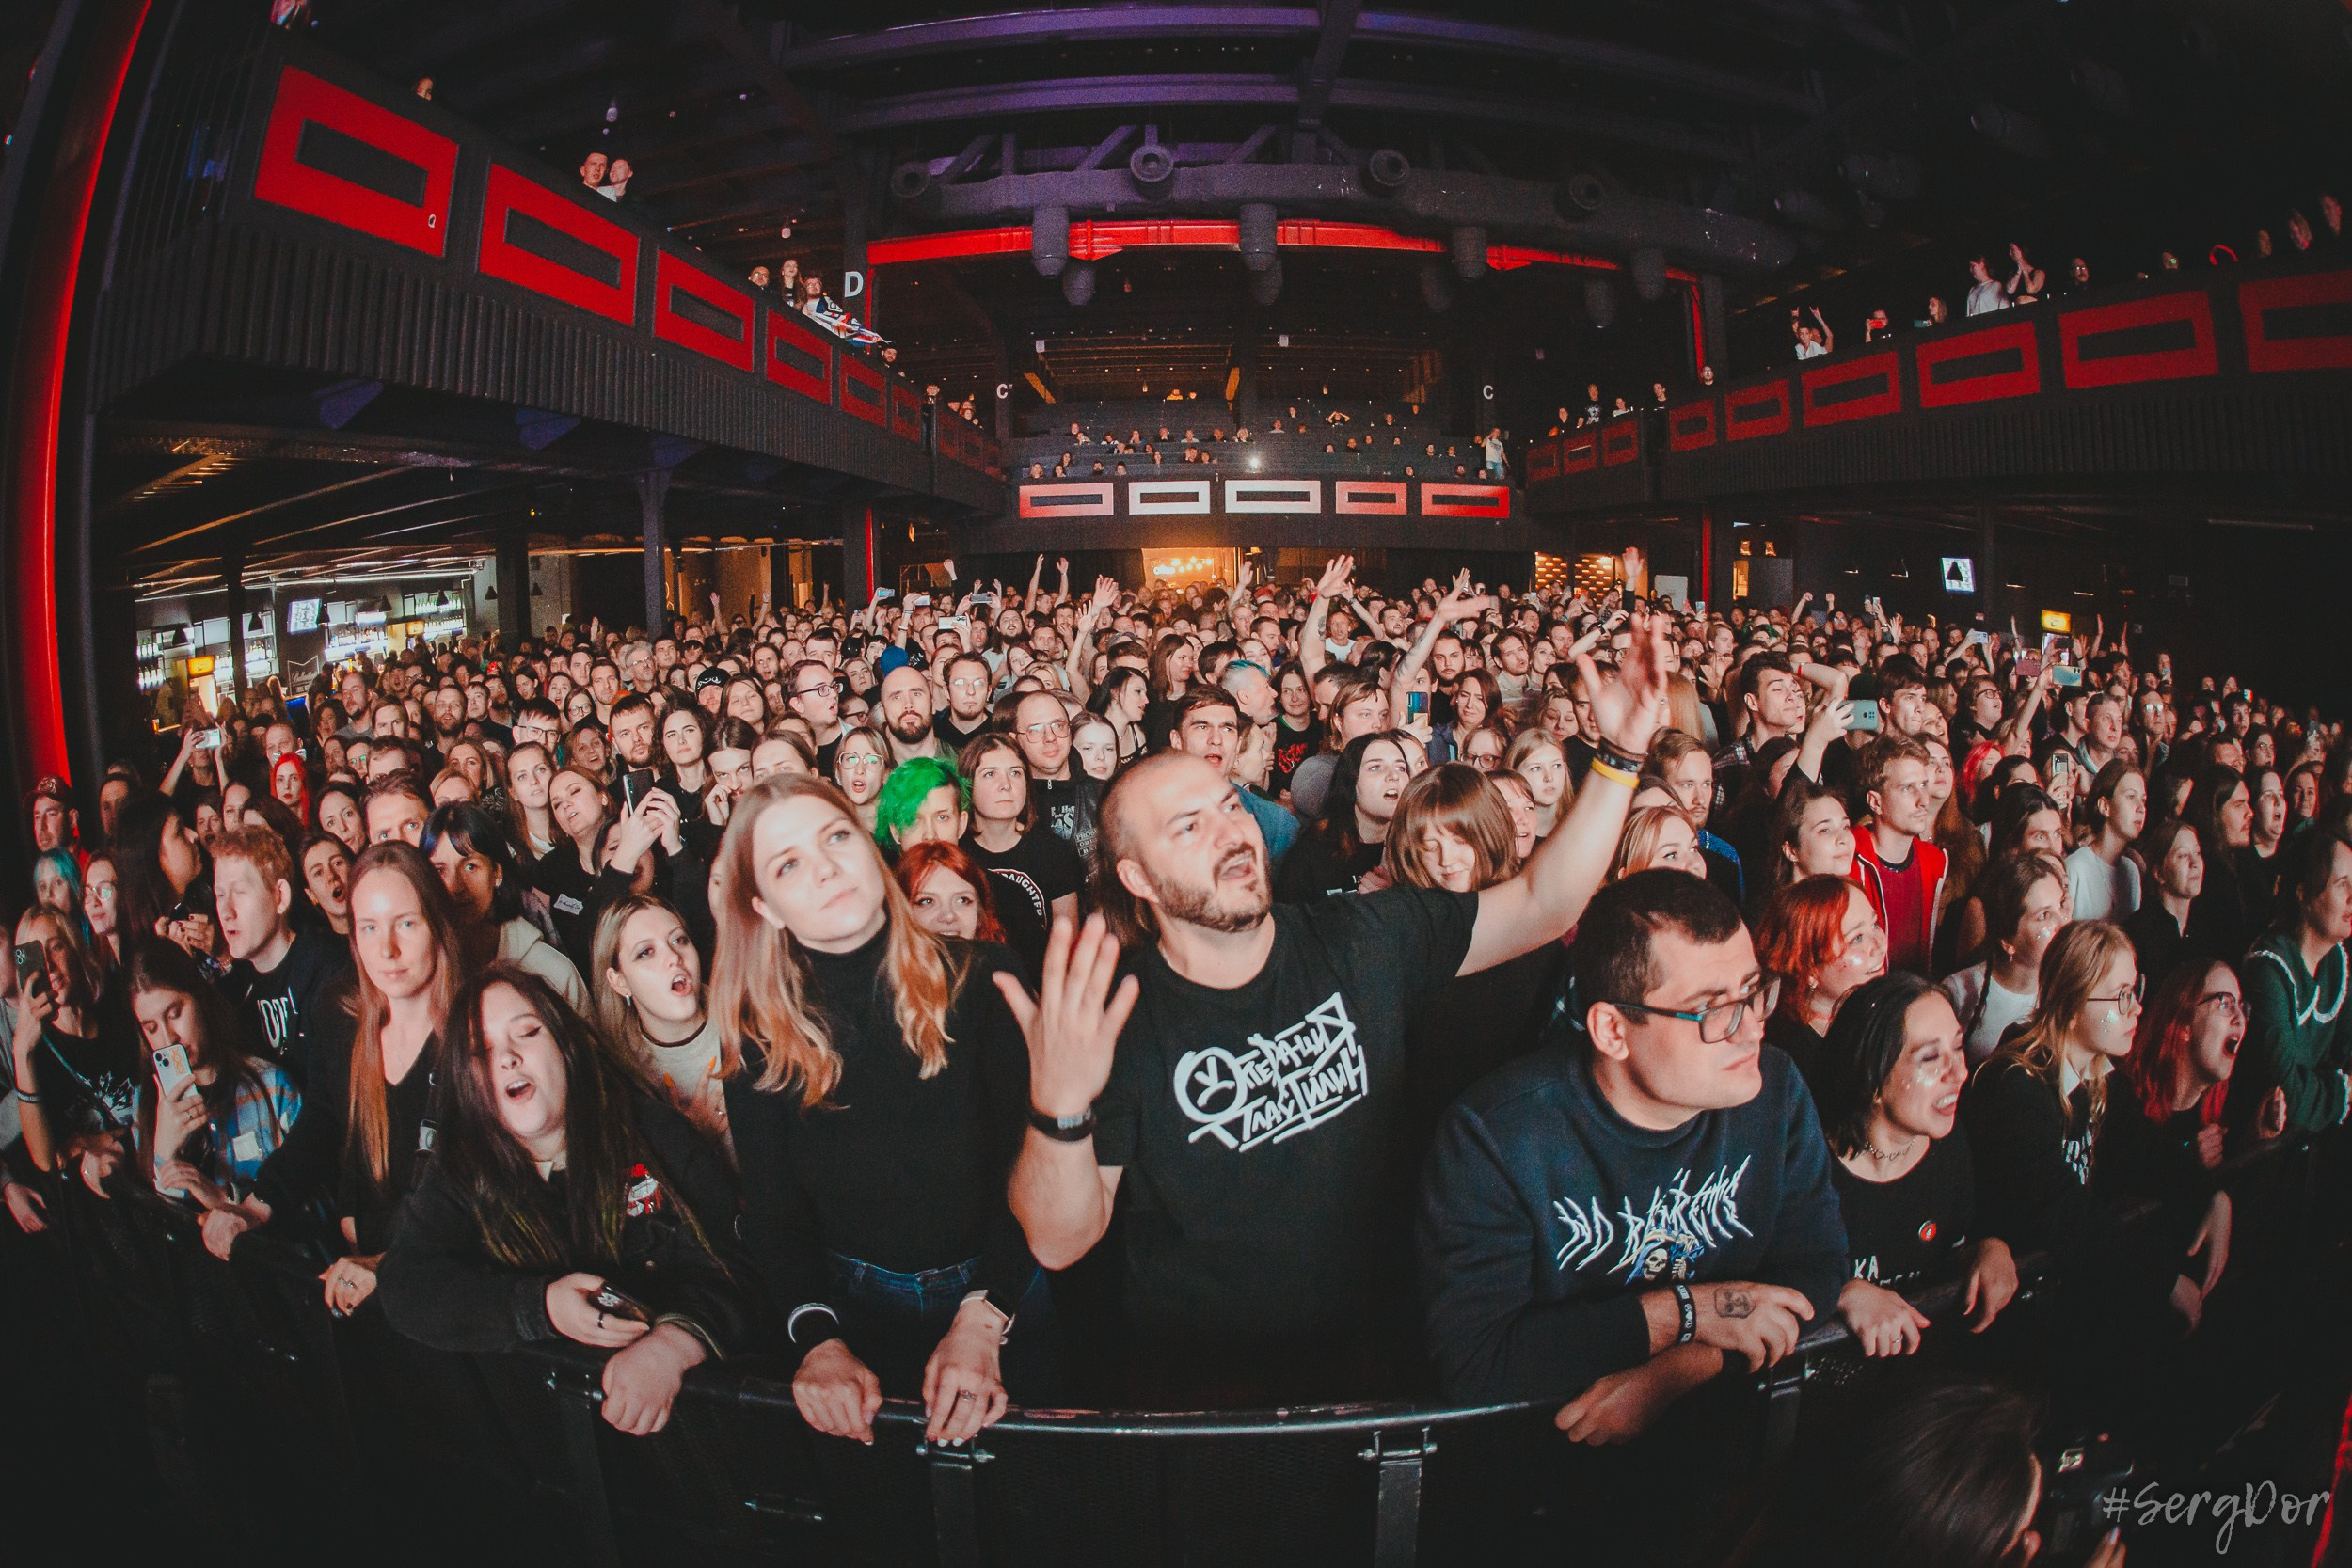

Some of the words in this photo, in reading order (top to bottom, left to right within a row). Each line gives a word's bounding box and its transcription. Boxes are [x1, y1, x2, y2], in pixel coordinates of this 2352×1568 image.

[845, 271, 864, 297] D
[997, 383, 1009, 399] C
[1483, 384, 1494, 400] C
